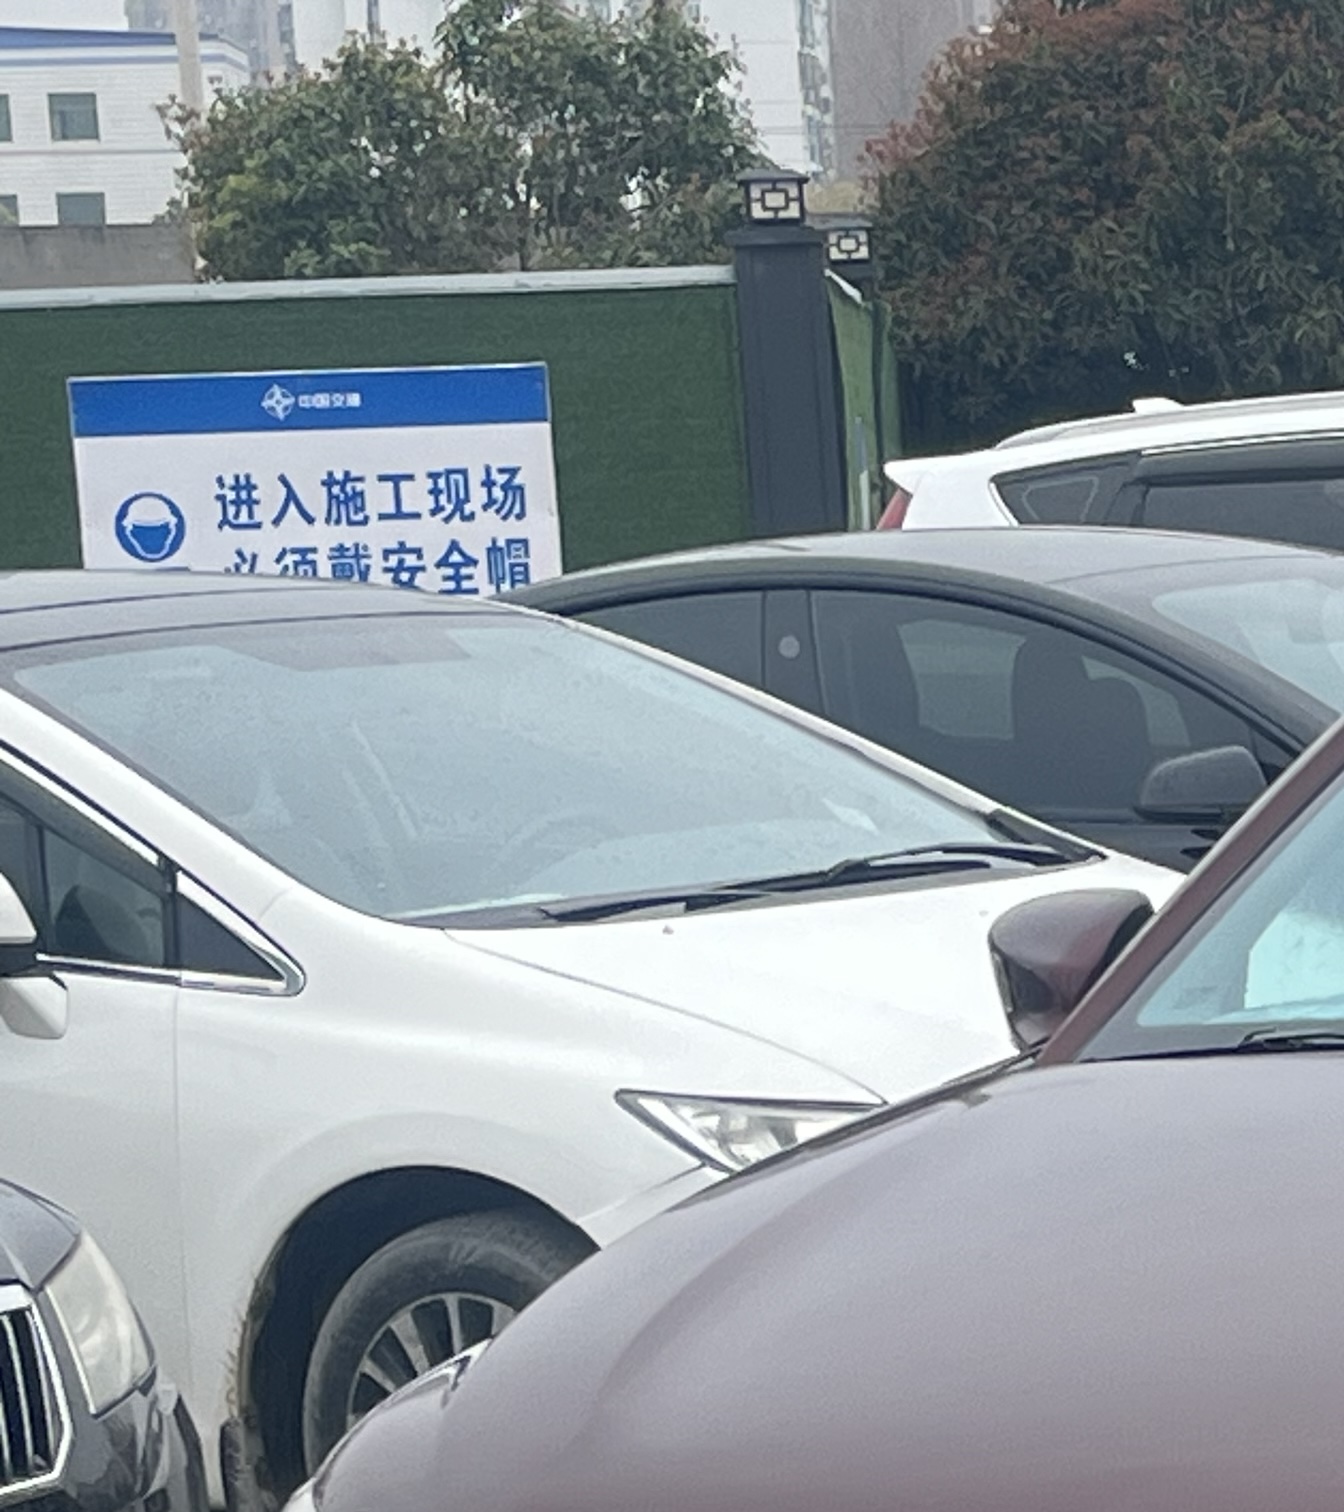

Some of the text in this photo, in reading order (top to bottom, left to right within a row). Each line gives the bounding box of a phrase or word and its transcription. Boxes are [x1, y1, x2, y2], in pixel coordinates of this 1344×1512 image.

[214, 464, 527, 531] 进入施工现场
